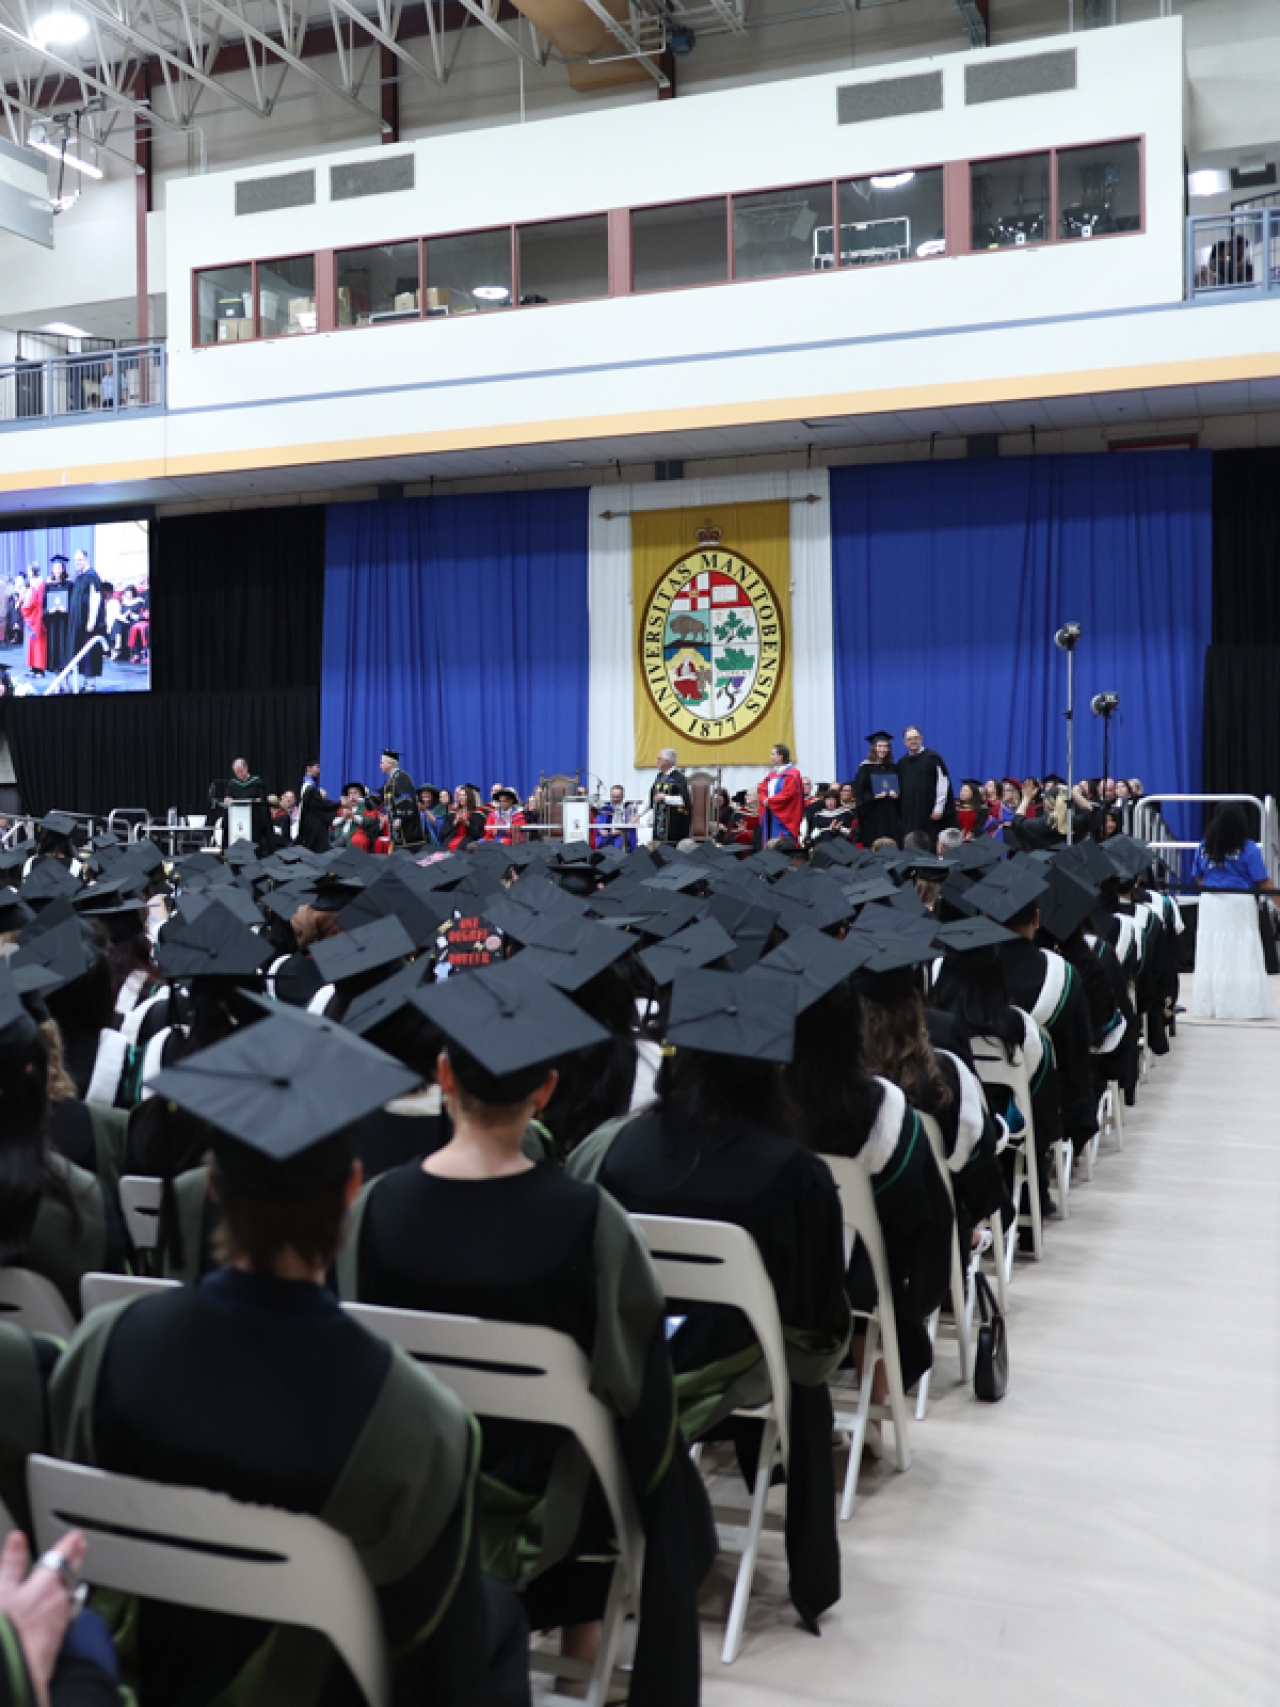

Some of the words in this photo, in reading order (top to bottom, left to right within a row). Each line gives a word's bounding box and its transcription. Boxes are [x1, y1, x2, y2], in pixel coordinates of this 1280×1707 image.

[646, 562, 692, 718] UNIVERSITAS
[700, 554, 778, 713] MANITOBENSIS
[688, 718, 737, 737] 1877
